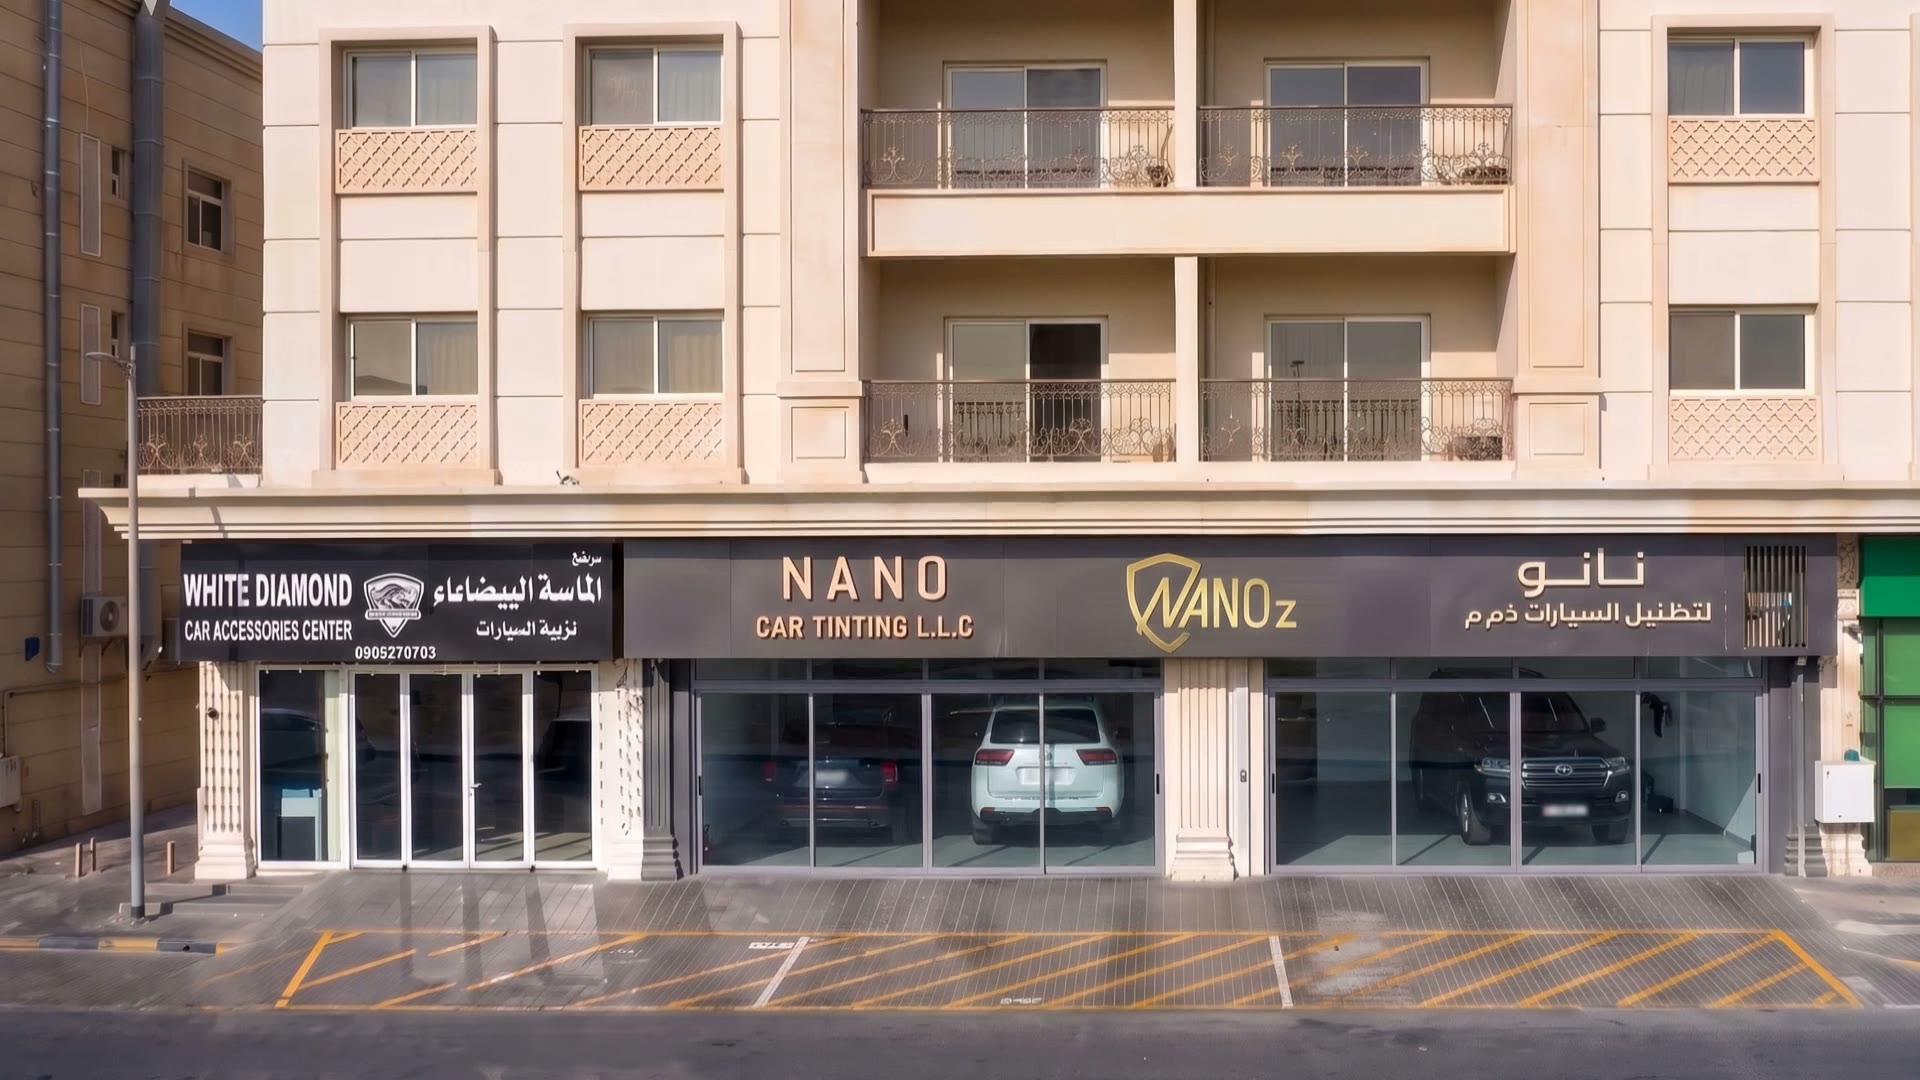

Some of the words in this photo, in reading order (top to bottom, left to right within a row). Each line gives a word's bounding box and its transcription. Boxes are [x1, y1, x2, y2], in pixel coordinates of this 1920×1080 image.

[782, 555, 947, 600] NANO
[1517, 547, 1644, 598] نانو
[183, 573, 249, 607] WHITE
[256, 573, 353, 607] DIAMOND
[538, 572, 602, 604] الماسة
[756, 615, 804, 638] CAR
[813, 615, 908, 638] TINTING
[917, 615, 973, 638] L.L.C
[1525, 602, 1619, 627] السيارات
[184, 620, 210, 641] CAR
[213, 620, 299, 641] ACCESSORIES
[302, 619, 353, 641] CENTER
[476, 619, 536, 641] السيارات
[354, 645, 437, 660] 0905270703
